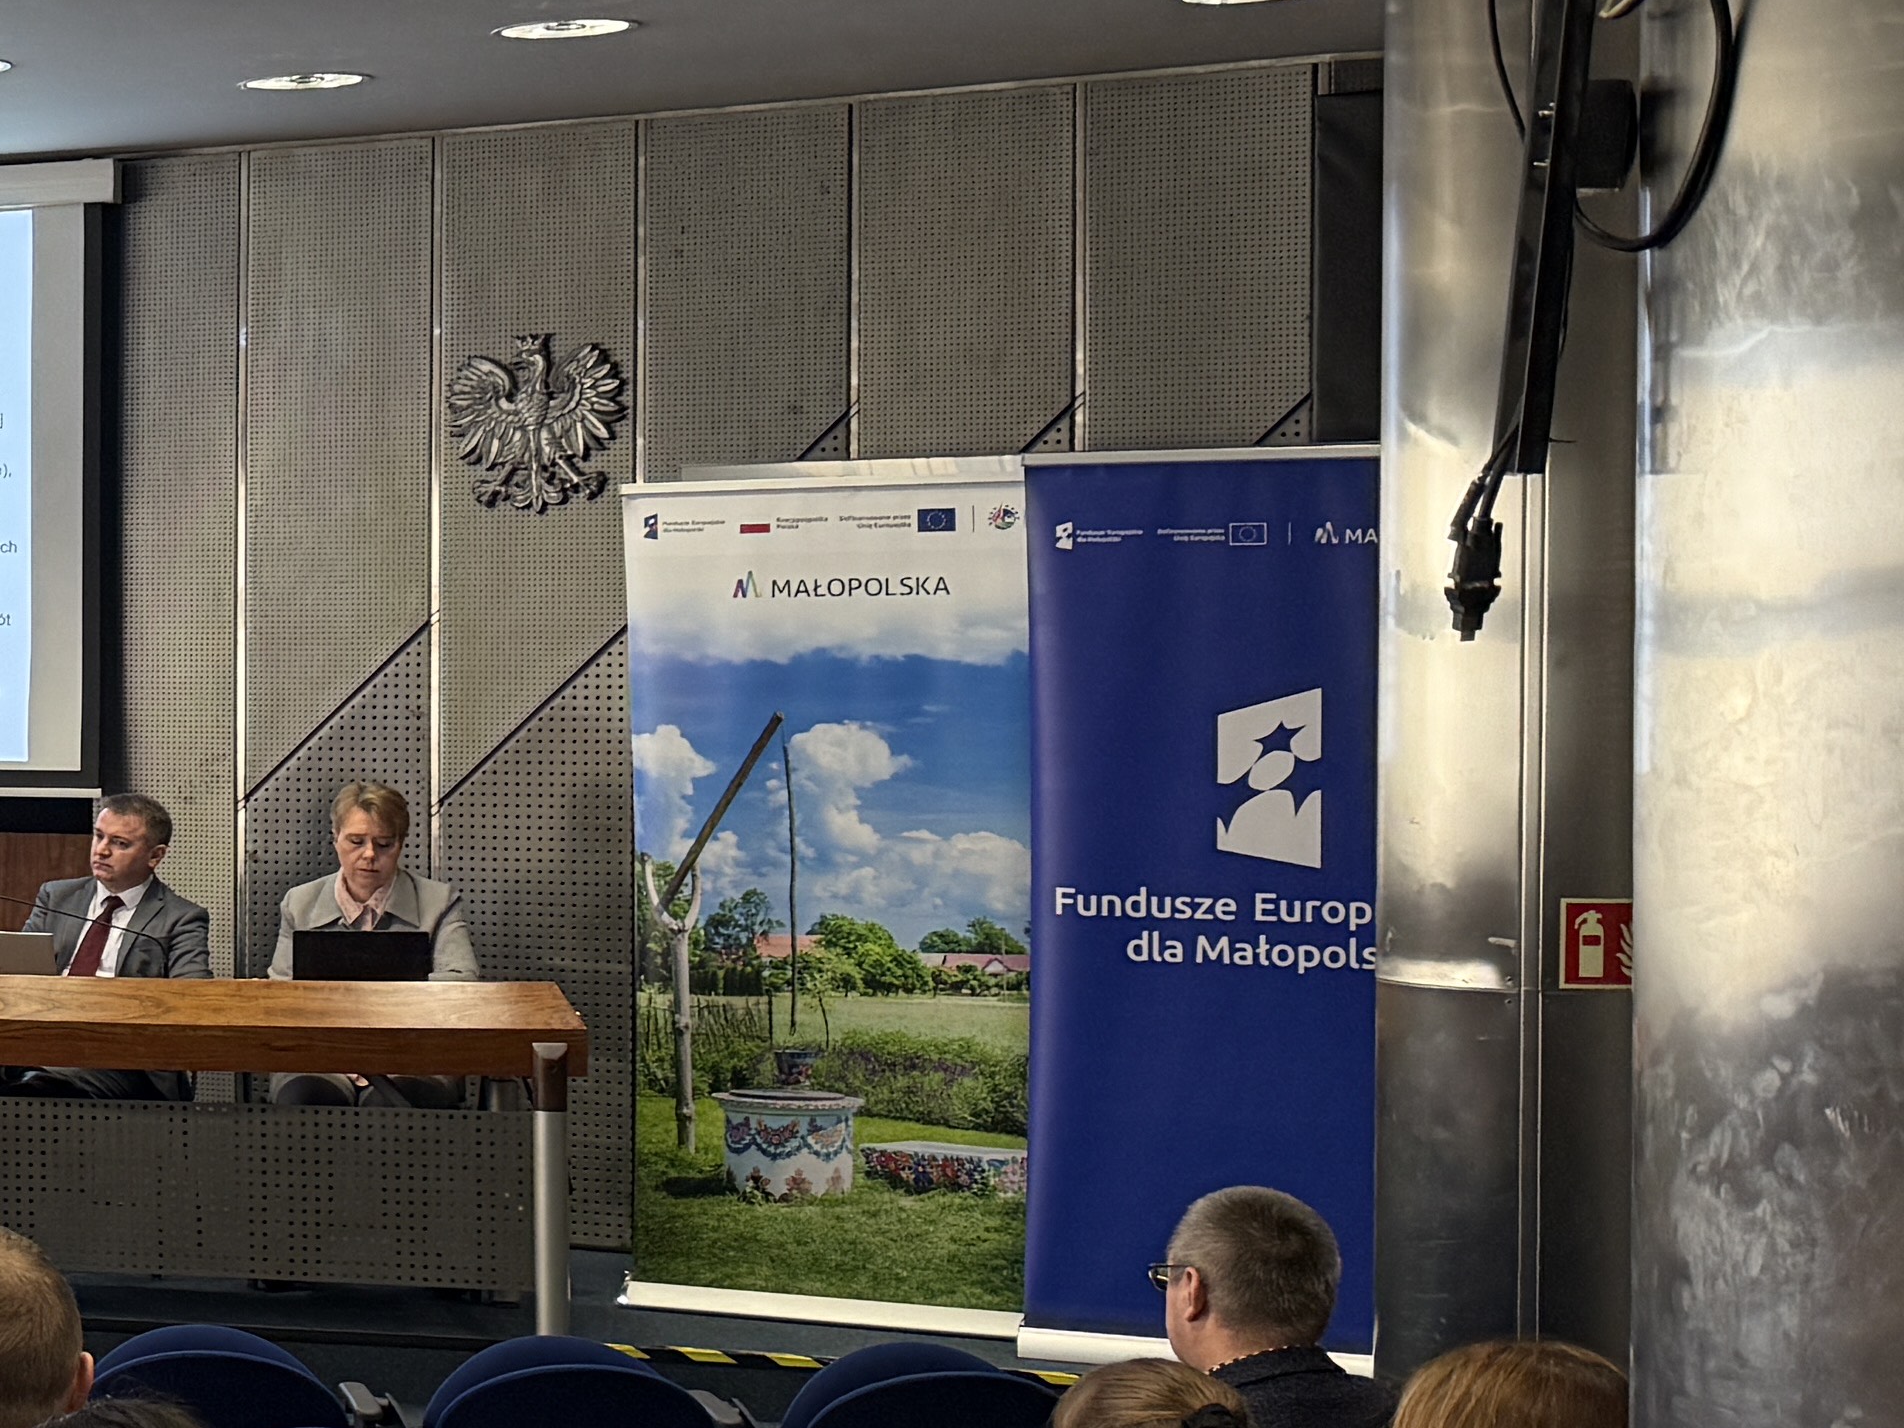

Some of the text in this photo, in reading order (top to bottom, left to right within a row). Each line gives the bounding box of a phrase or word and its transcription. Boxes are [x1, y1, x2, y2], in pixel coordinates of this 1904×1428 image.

[771, 575, 951, 598] MAŁOPOLSKA
[1055, 886, 1373, 931] Fundusze Europ
[1126, 930, 1184, 963] dla
